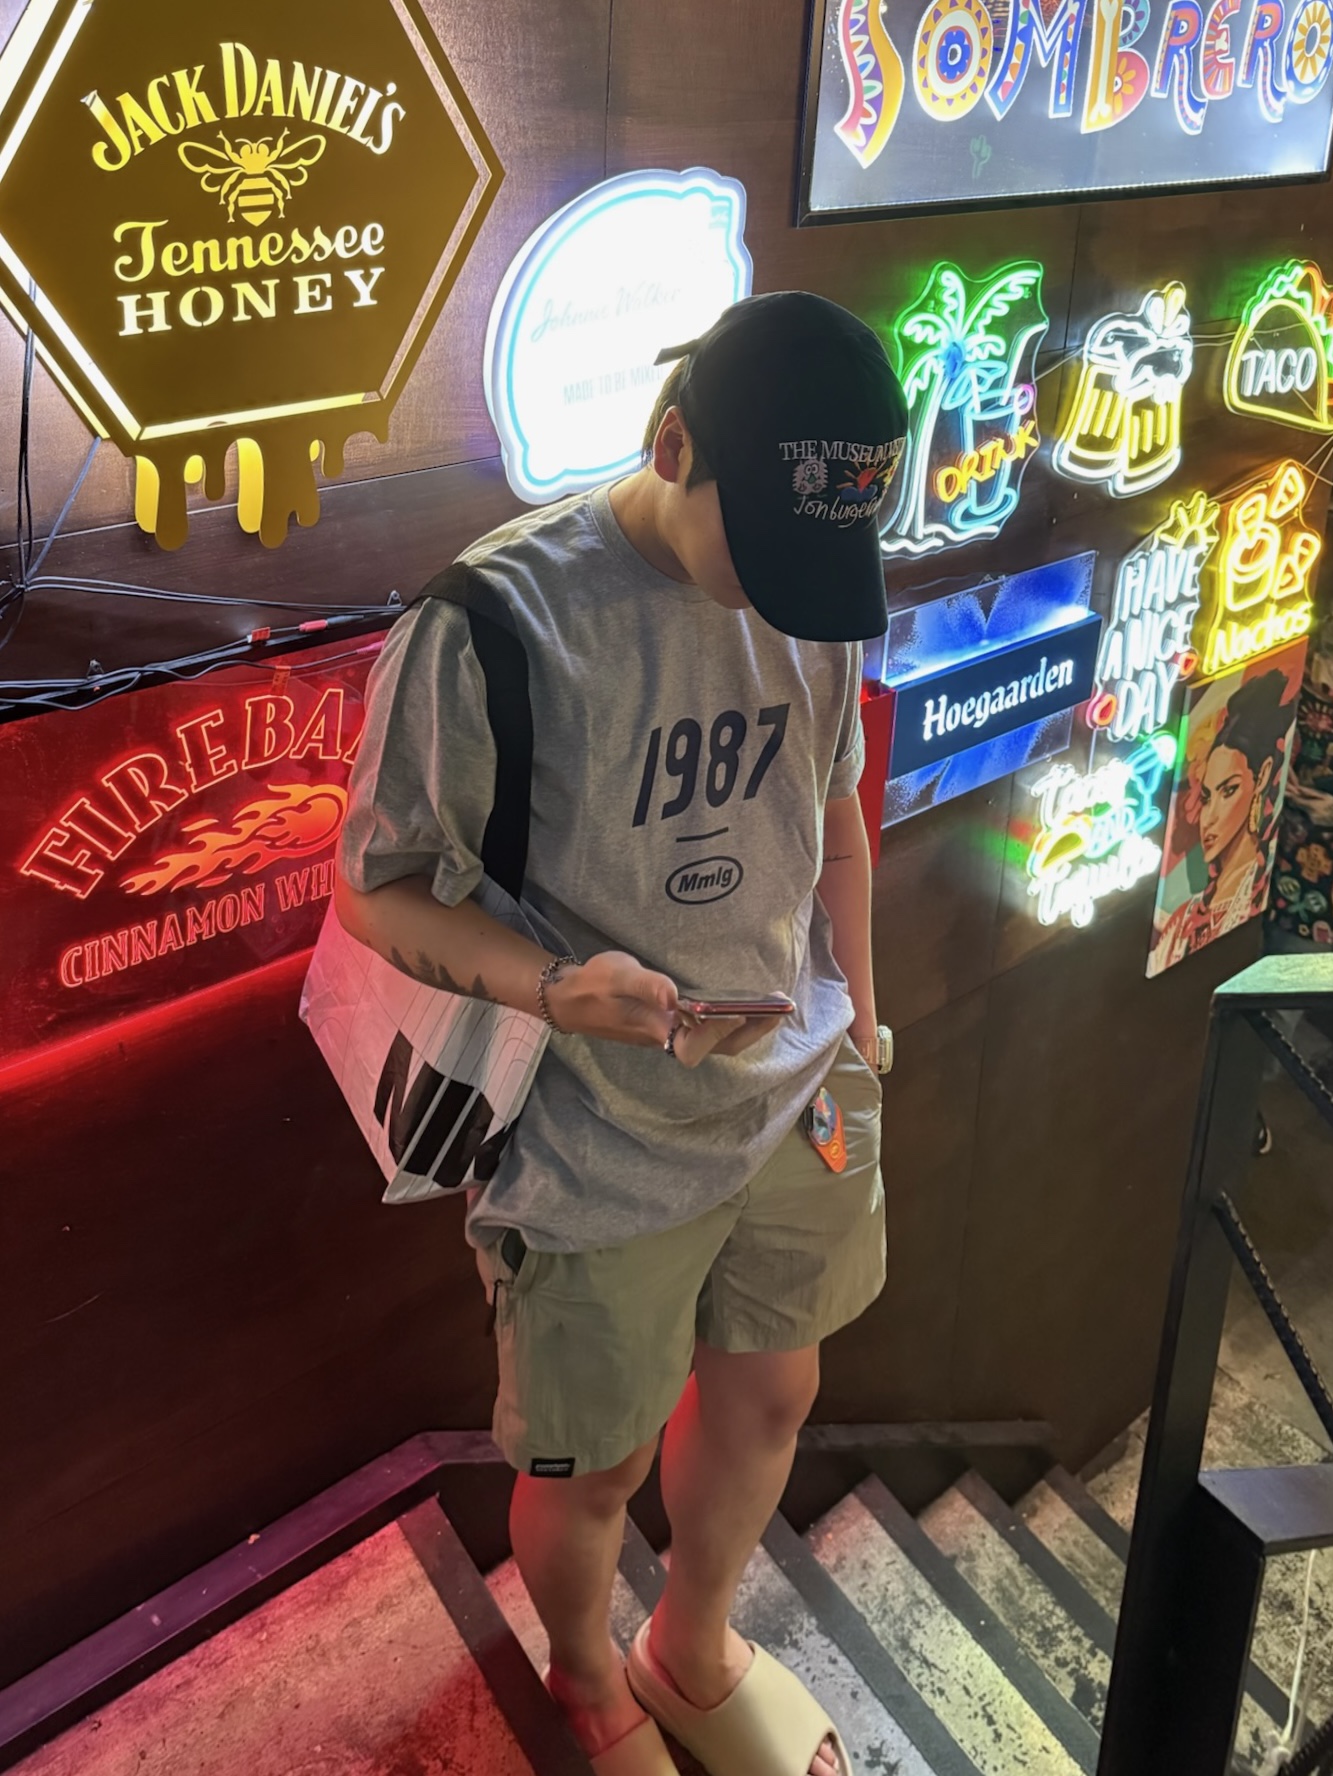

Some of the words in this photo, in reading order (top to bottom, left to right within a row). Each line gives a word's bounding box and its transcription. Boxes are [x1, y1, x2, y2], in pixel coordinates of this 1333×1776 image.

[80, 65, 220, 172] JACK
[219, 41, 407, 155] DANIEL'S
[834, 0, 1332, 168] SOMBRERO
[113, 219, 386, 282] Tennessee
[117, 268, 385, 337] HONEY
[563, 378, 594, 406] MADE
[598, 374, 612, 395] TO
[614, 370, 626, 392] BE
[1241, 347, 1317, 397] TACO
[779, 440, 817, 461] THE
[1121, 545, 1208, 622] HAVE
[1102, 630, 1123, 681] A
[1124, 603, 1200, 681] NICE
[1210, 601, 1312, 673] Nachos
[922, 657, 1074, 741] Hoegaarden
[1114, 661, 1179, 738] DAY
[20, 688, 365, 899] FIREBA
[632, 703, 790, 828] 1987
[60, 884, 266, 988] CINNAMON
